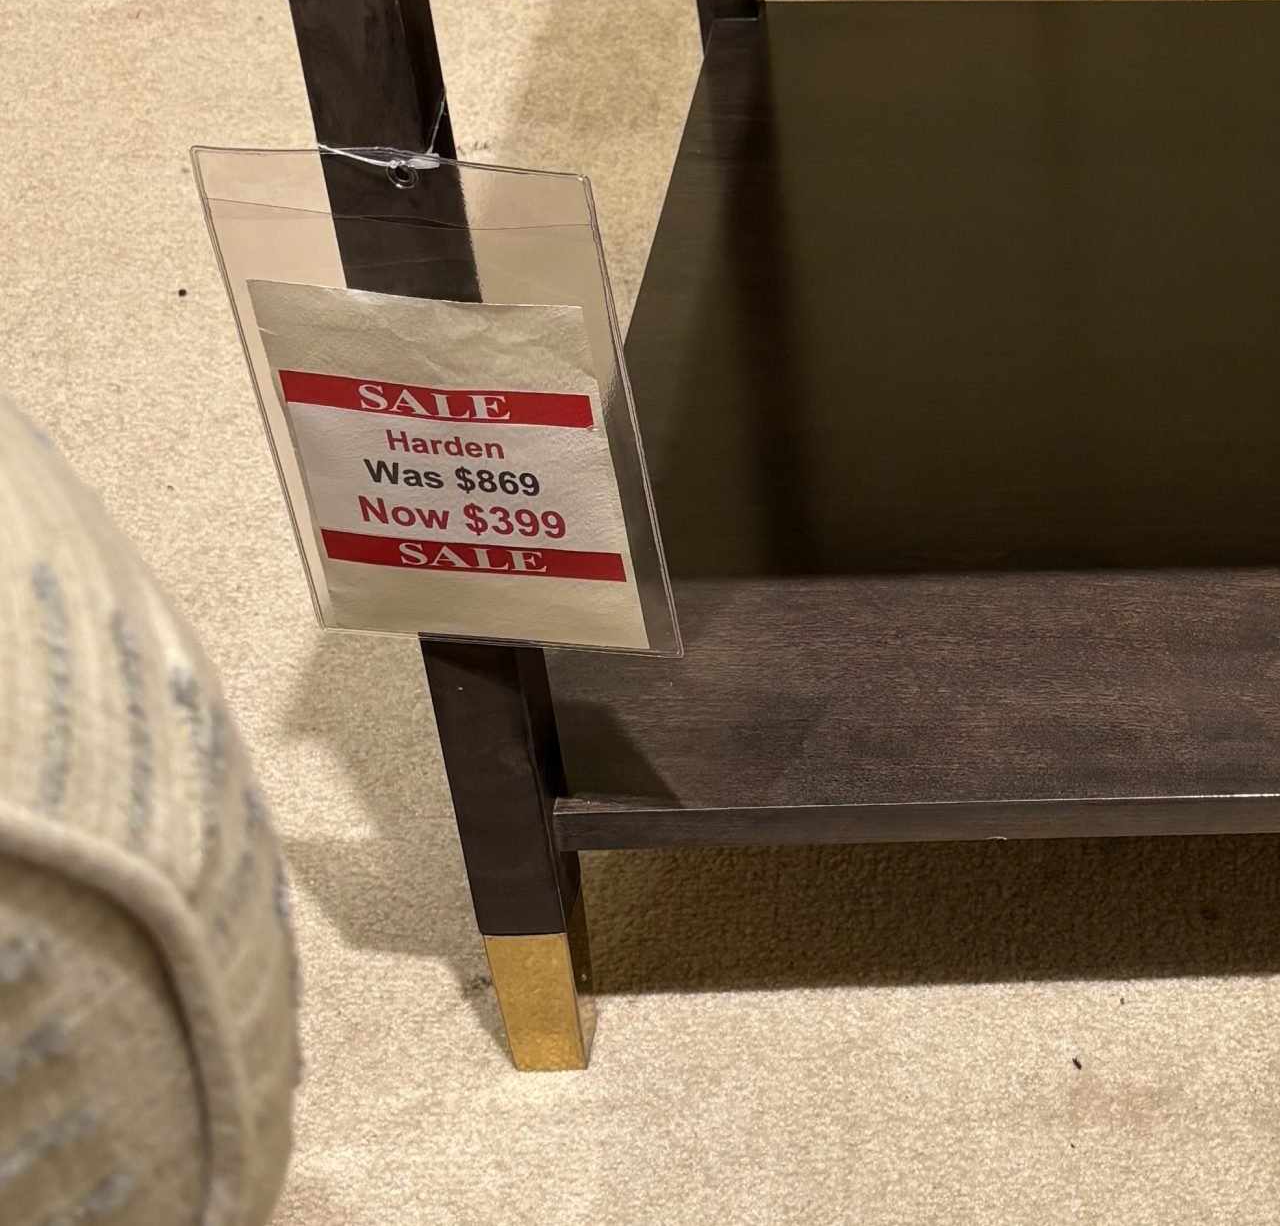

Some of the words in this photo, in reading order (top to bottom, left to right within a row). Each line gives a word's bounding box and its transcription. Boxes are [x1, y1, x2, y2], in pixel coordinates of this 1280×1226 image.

[358, 383, 511, 420] SALE
[385, 429, 505, 459] Harden
[363, 459, 444, 489] Was
[455, 466, 540, 496] $869
[358, 495, 449, 530] Now
[463, 503, 566, 539] $399
[397, 542, 547, 573] SALE
